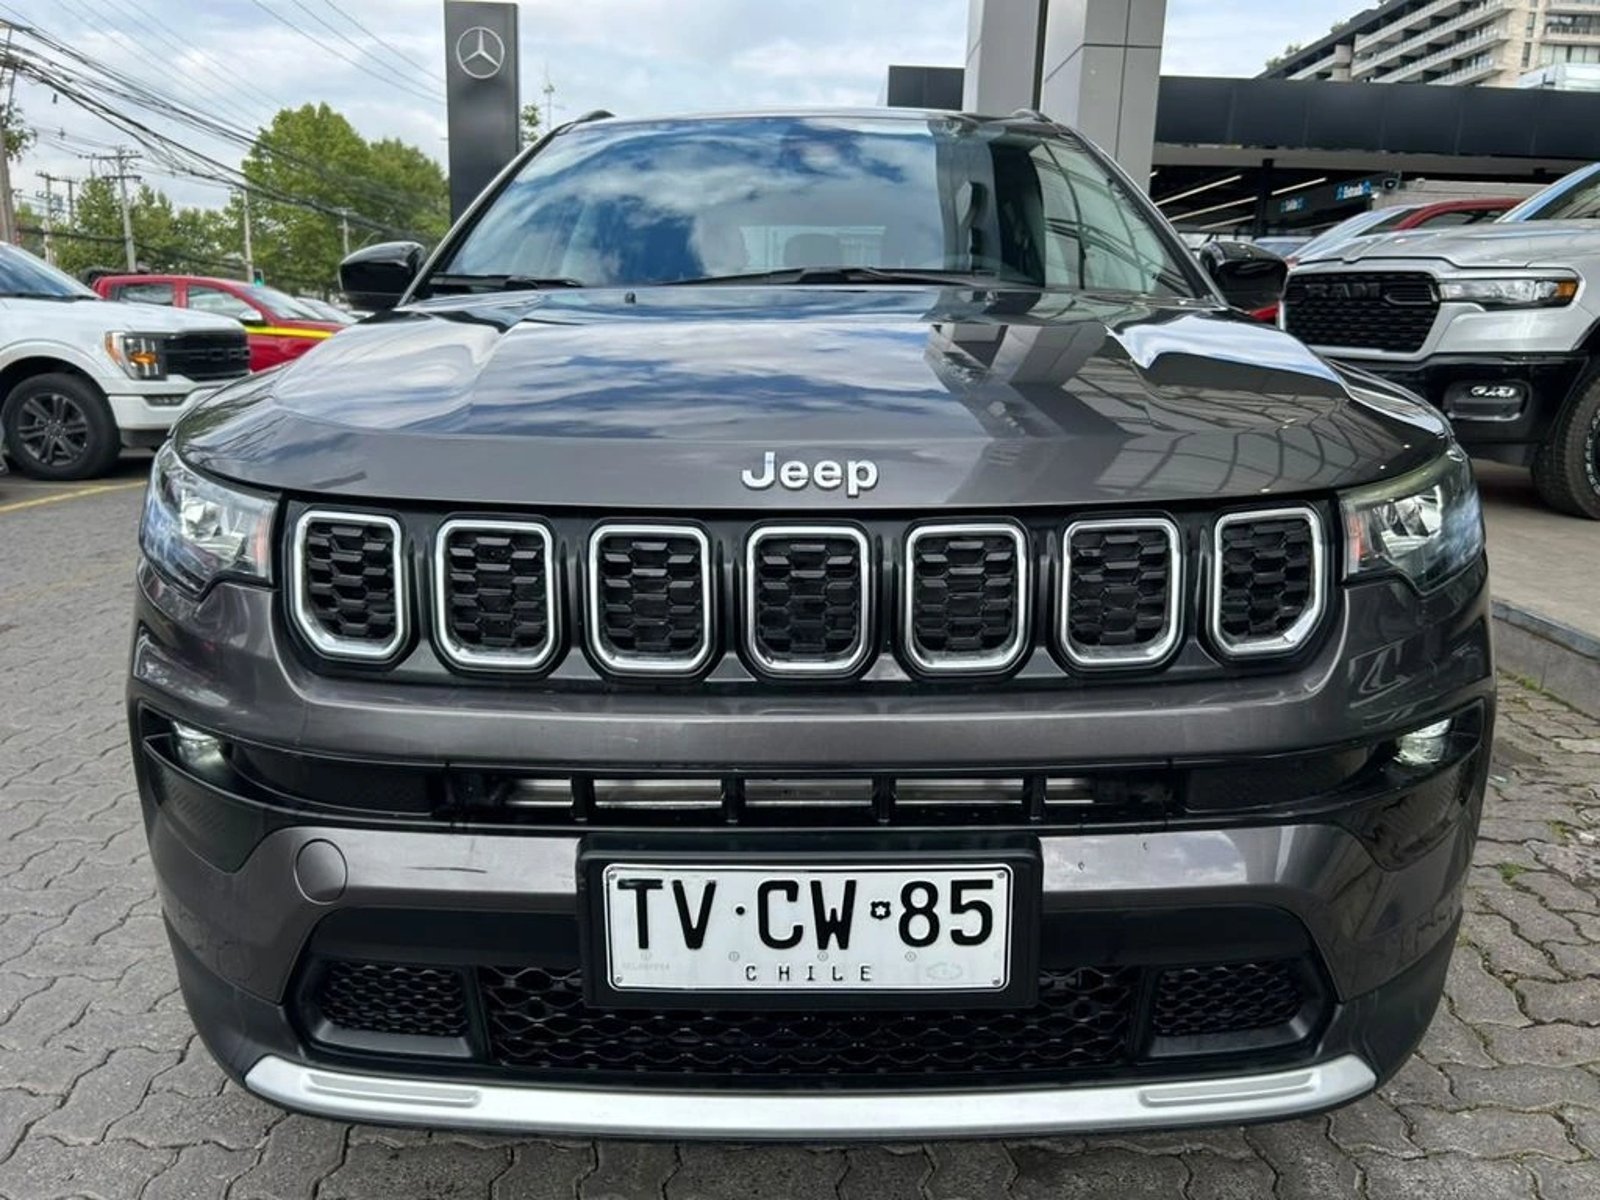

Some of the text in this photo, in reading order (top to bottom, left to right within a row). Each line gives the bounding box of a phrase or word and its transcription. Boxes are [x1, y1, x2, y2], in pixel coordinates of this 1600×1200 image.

[1305, 282, 1381, 298] RAM
[741, 451, 879, 498] Jeep
[745, 965, 874, 982] CHILE
